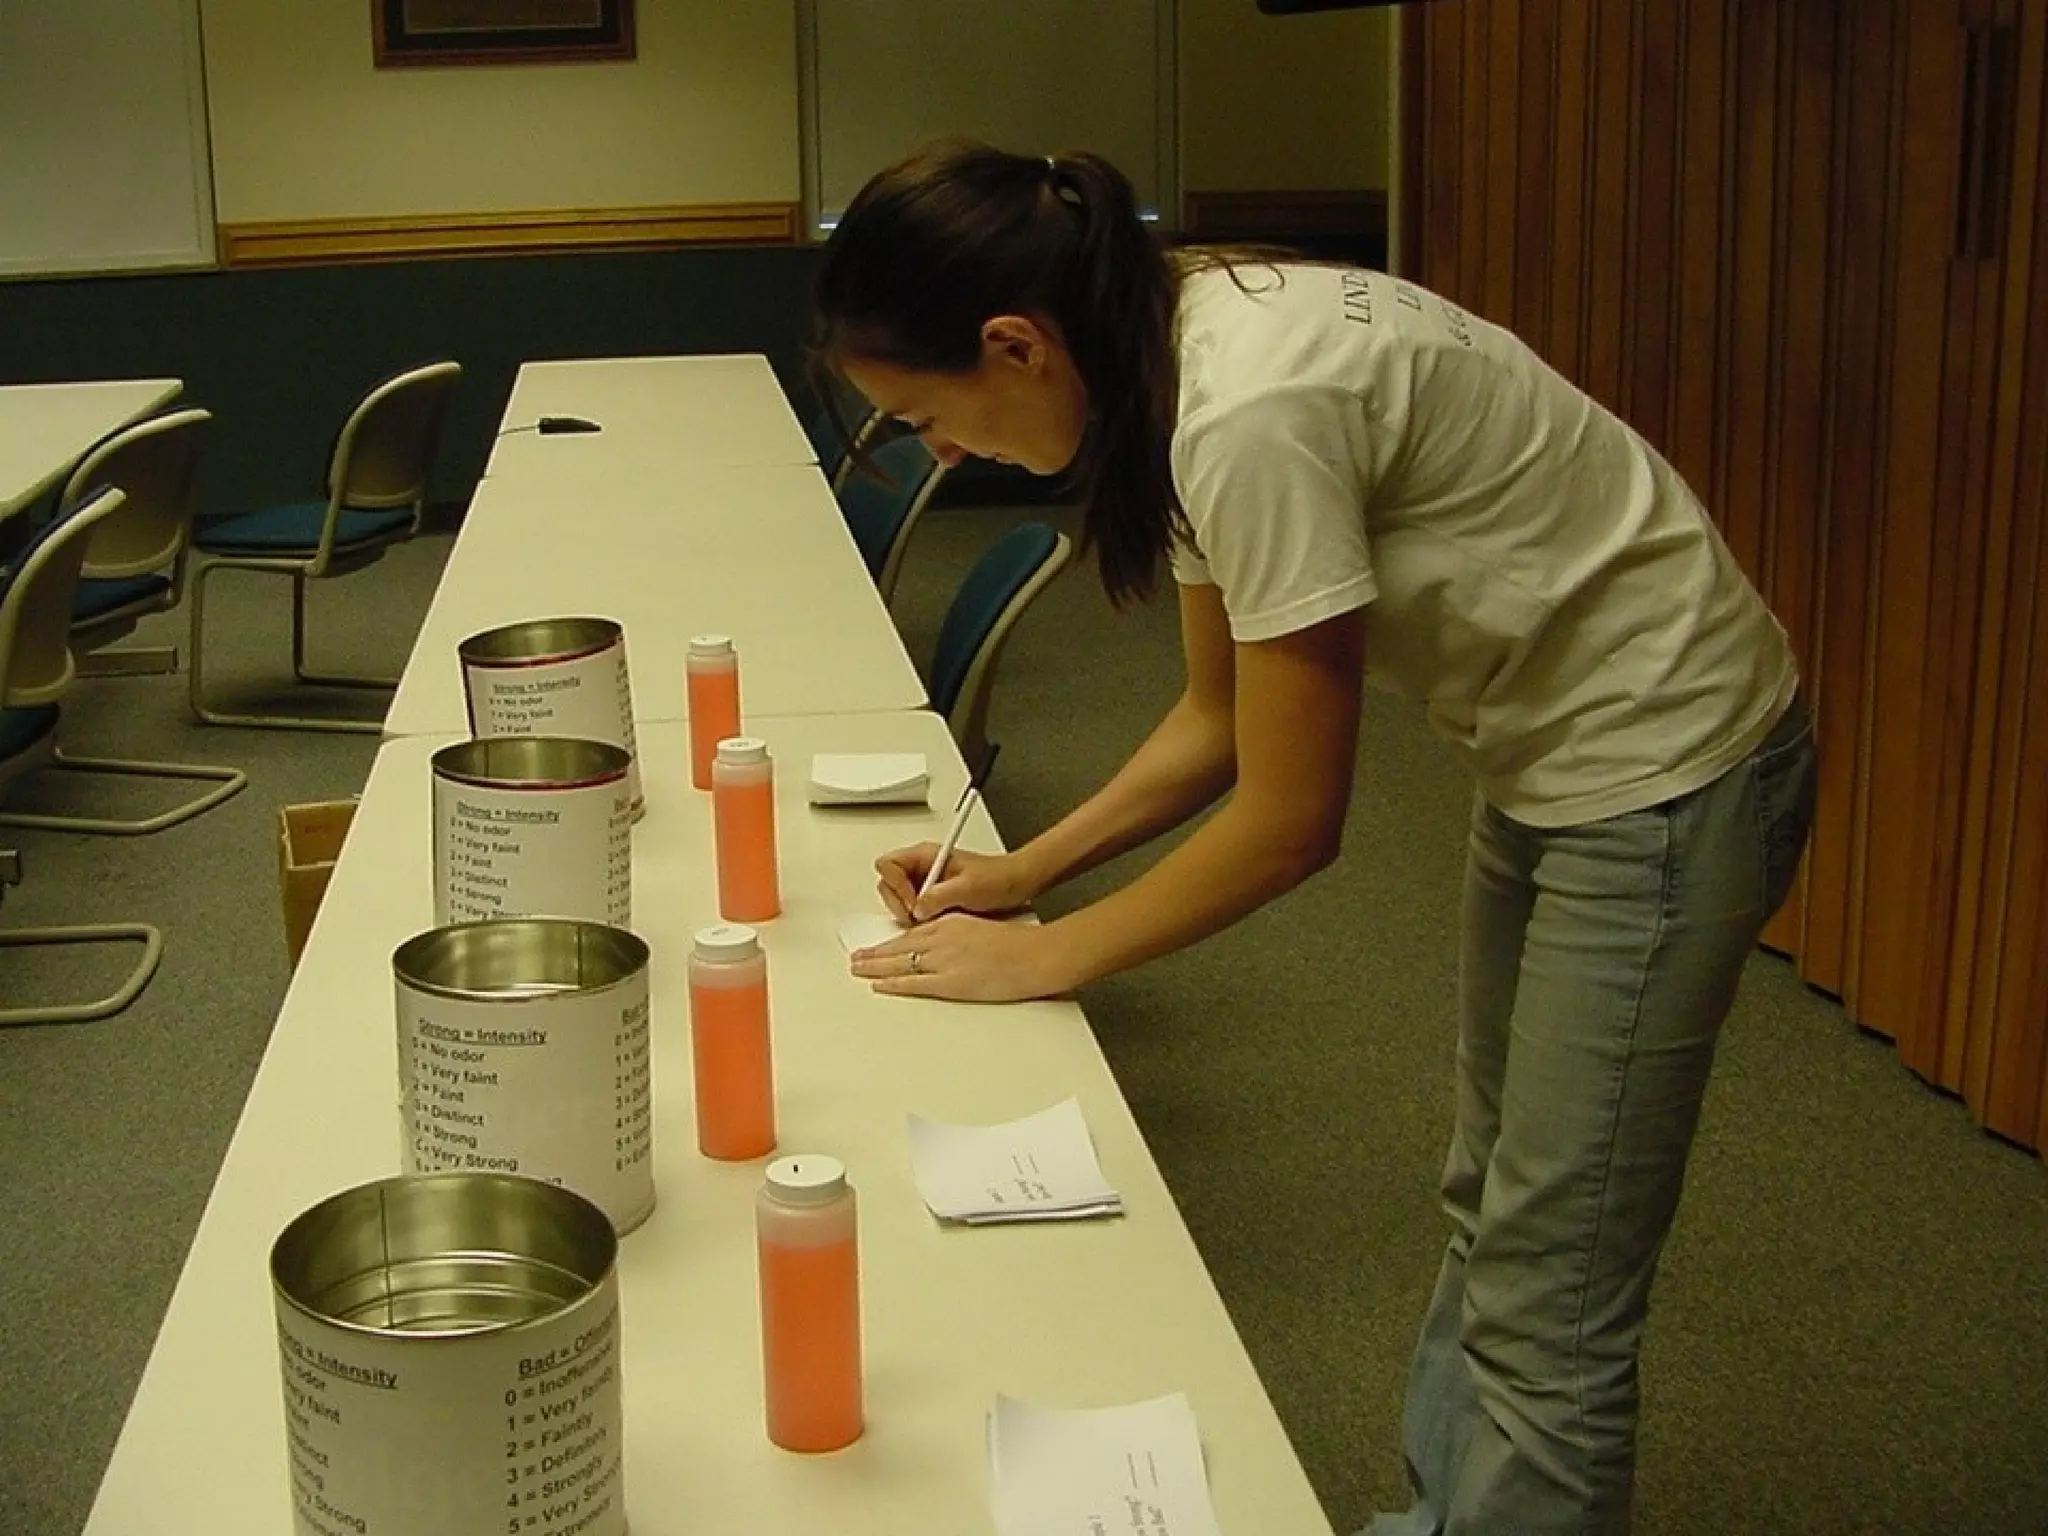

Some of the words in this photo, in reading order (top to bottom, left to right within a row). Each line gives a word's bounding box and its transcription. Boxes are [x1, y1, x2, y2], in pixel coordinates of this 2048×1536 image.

[477, 1028, 547, 1045] Intensity
[451, 1048, 485, 1062] odor
[430, 1062, 460, 1084] Very
[432, 1083, 464, 1103] Faint
[431, 1104, 484, 1127] Distinct
[432, 1123, 478, 1149] Strong
[431, 1145, 460, 1168] Very
[466, 1153, 518, 1172] Strong
[318, 1350, 398, 1388] Intensity
[519, 1350, 555, 1377] Bad
[505, 1389, 517, 1407] 0
[507, 1415, 516, 1433] 1
[540, 1396, 578, 1421] Very
[506, 1441, 517, 1458] 2
[506, 1467, 518, 1483] 3
[506, 1493, 518, 1507] 4
[508, 1517, 520, 1534] 5
[542, 1500, 579, 1523] Very
